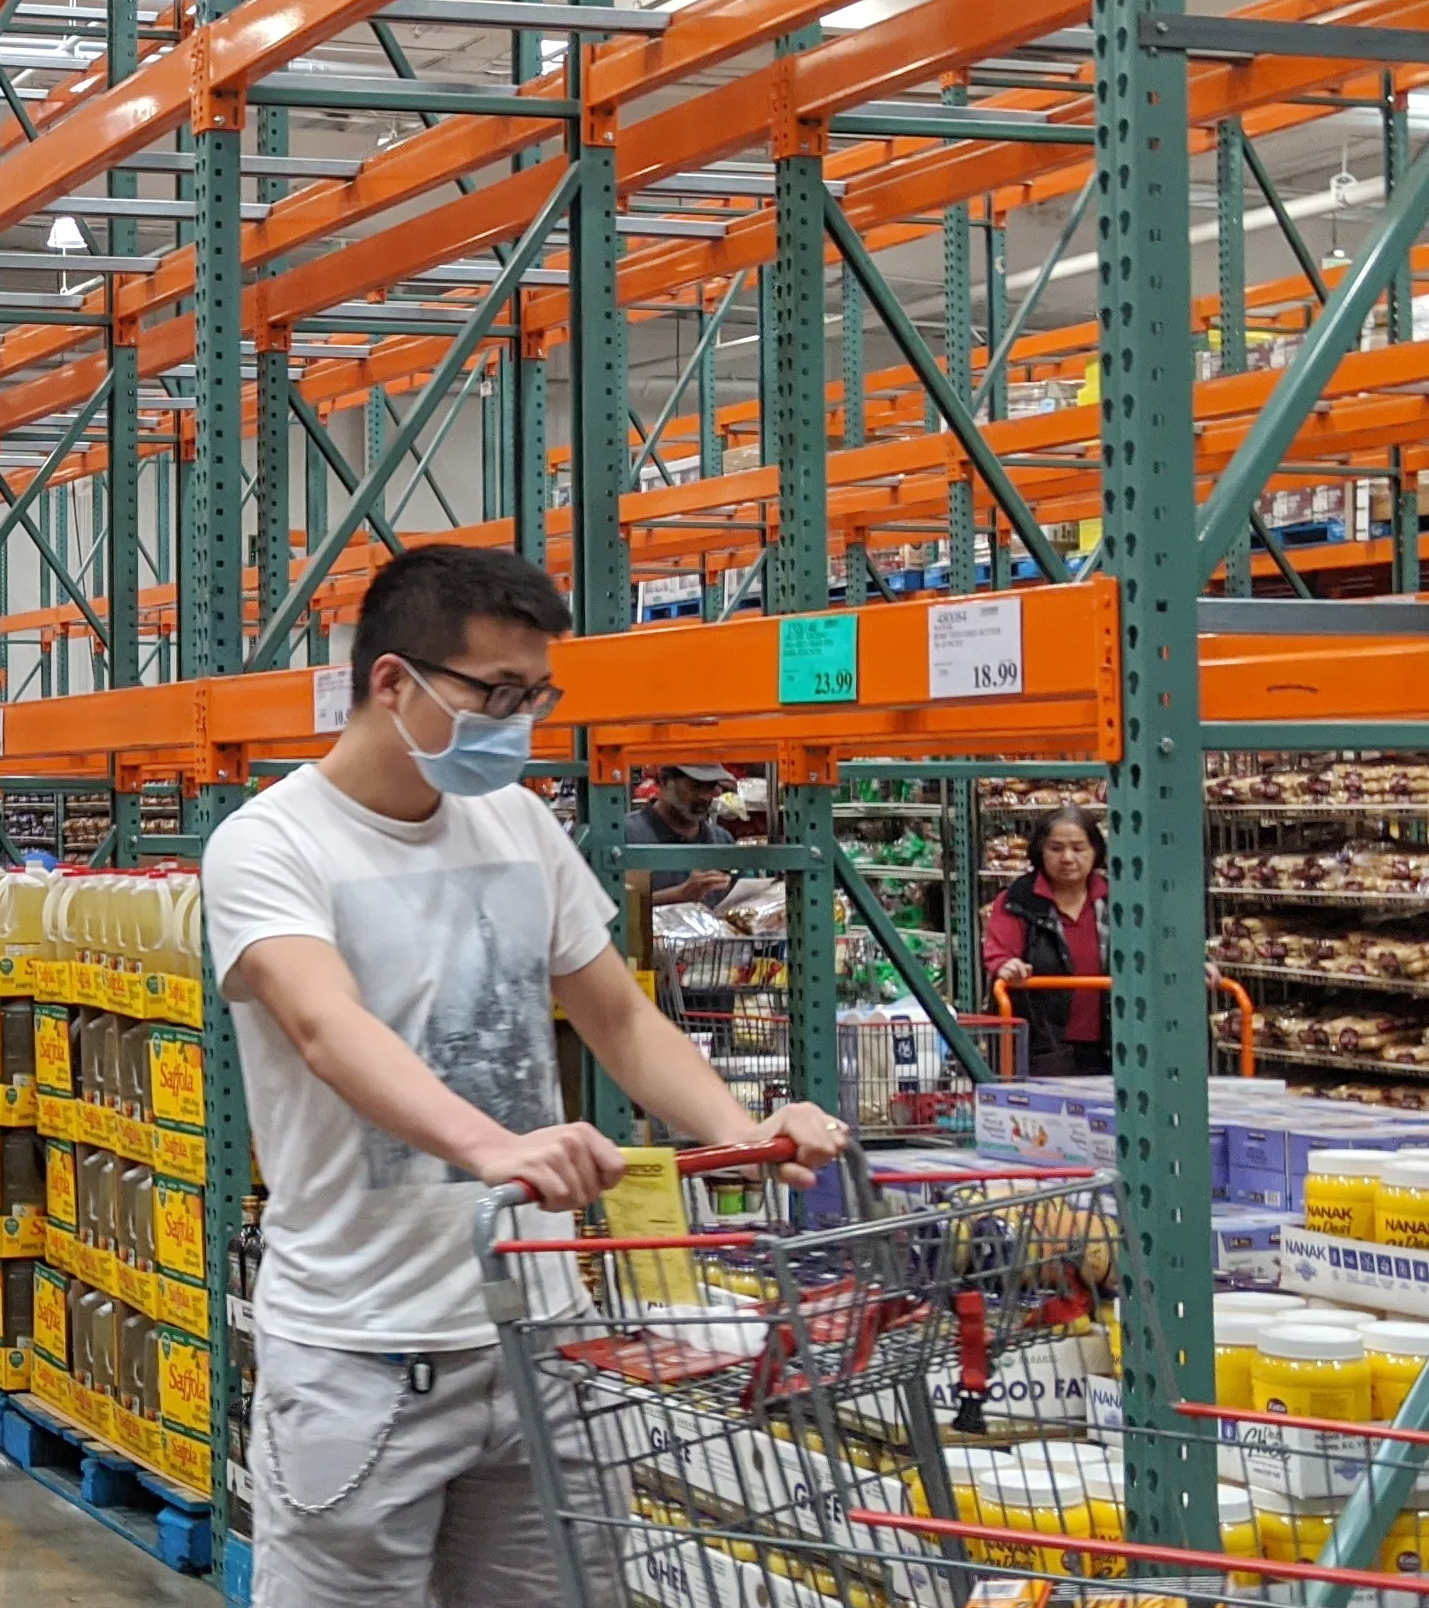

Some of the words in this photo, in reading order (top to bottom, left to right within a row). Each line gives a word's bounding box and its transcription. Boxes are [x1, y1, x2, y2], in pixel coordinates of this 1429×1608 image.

[814, 671, 853, 695] 23.99
[973, 662, 1018, 688] 18.99
[159, 1060, 194, 1098] Saffola
[1306, 1204, 1354, 1220] NANAK
[164, 1211, 195, 1248] Saffola
[1285, 1239, 1327, 1262] NANAK
[169, 1363, 207, 1402] Saffola
[988, 1380, 1046, 1401] OOD
[793, 1482, 843, 1524] GEE
